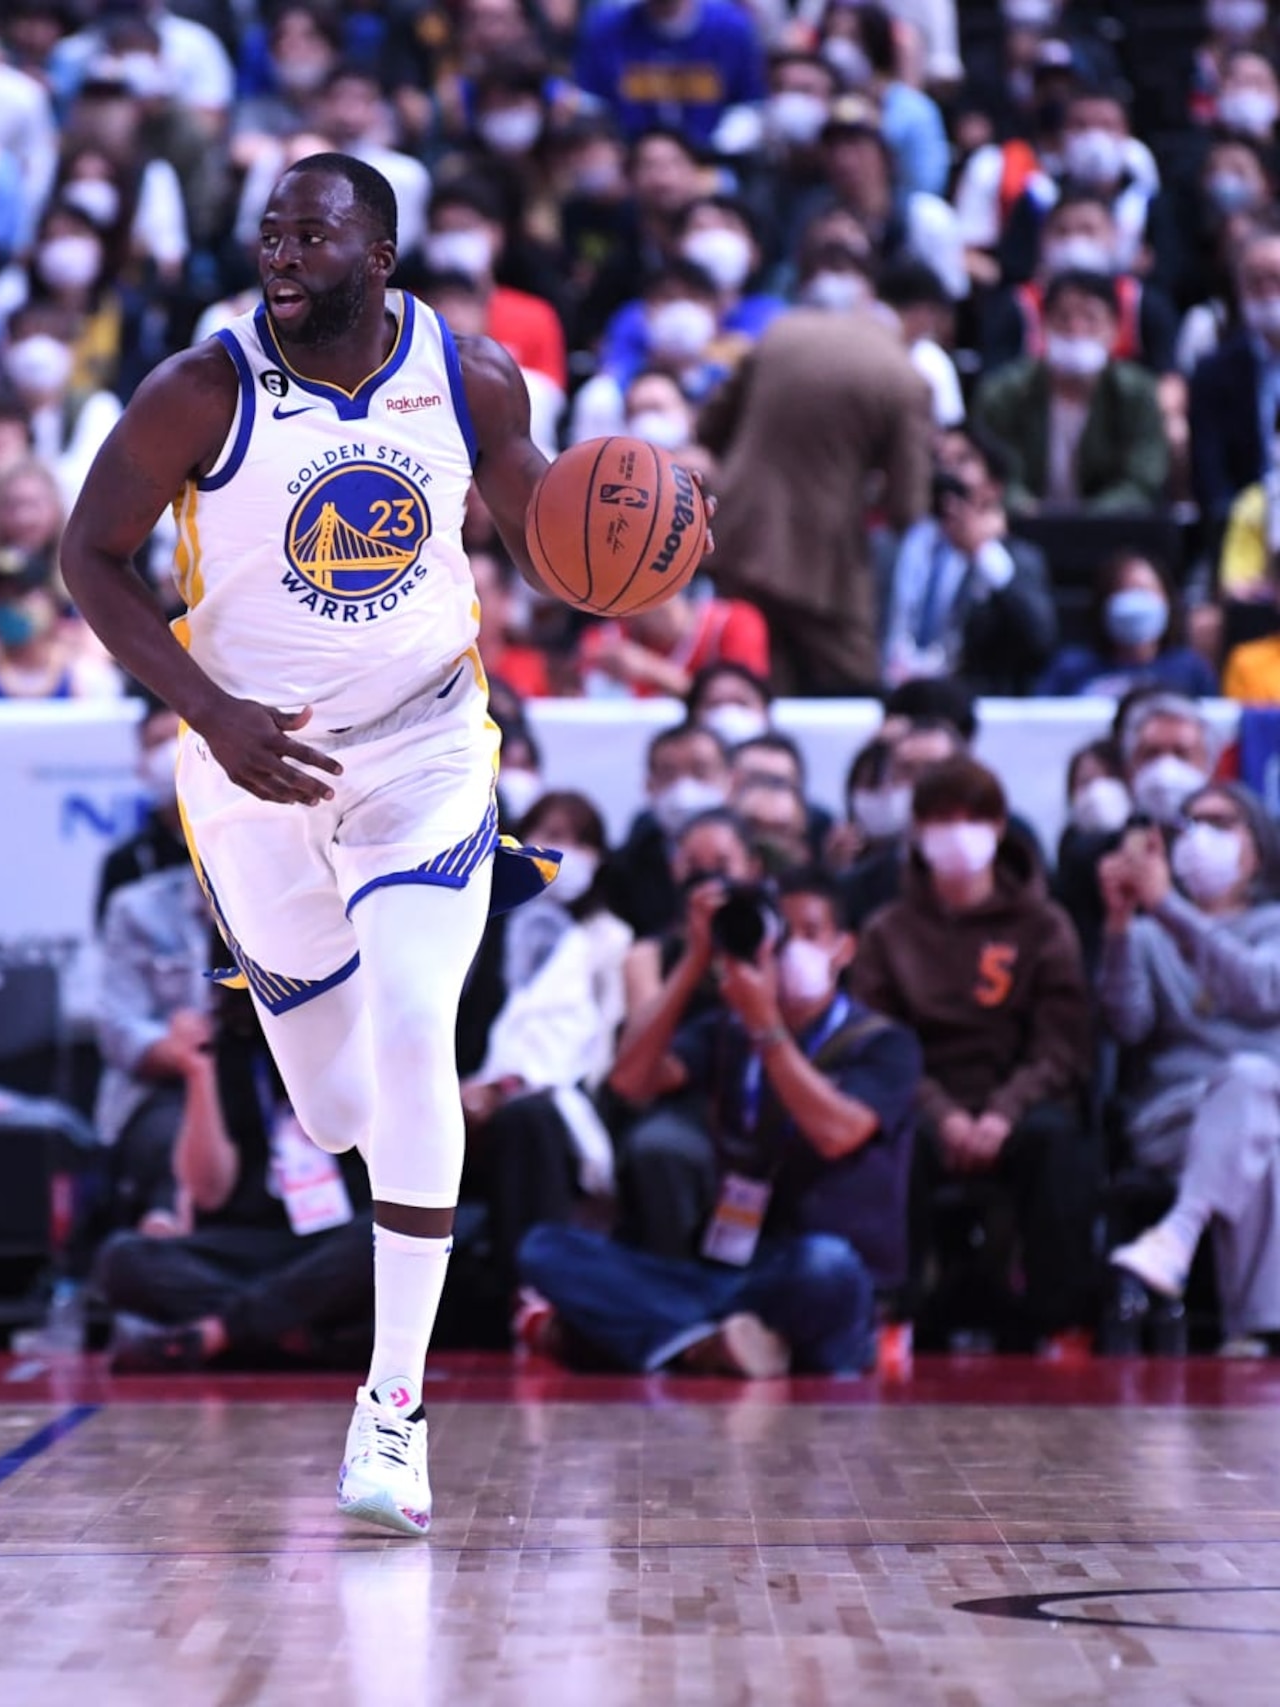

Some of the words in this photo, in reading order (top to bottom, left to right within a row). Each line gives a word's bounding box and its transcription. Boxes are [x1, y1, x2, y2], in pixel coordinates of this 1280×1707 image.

[265, 373, 283, 397] 6
[386, 394, 442, 412] Rakuten
[287, 443, 366, 495] GOLDEN
[376, 445, 433, 489] STATE
[368, 497, 416, 538] 23
[649, 463, 695, 574] Wilson
[281, 564, 427, 623] WARRIORS
